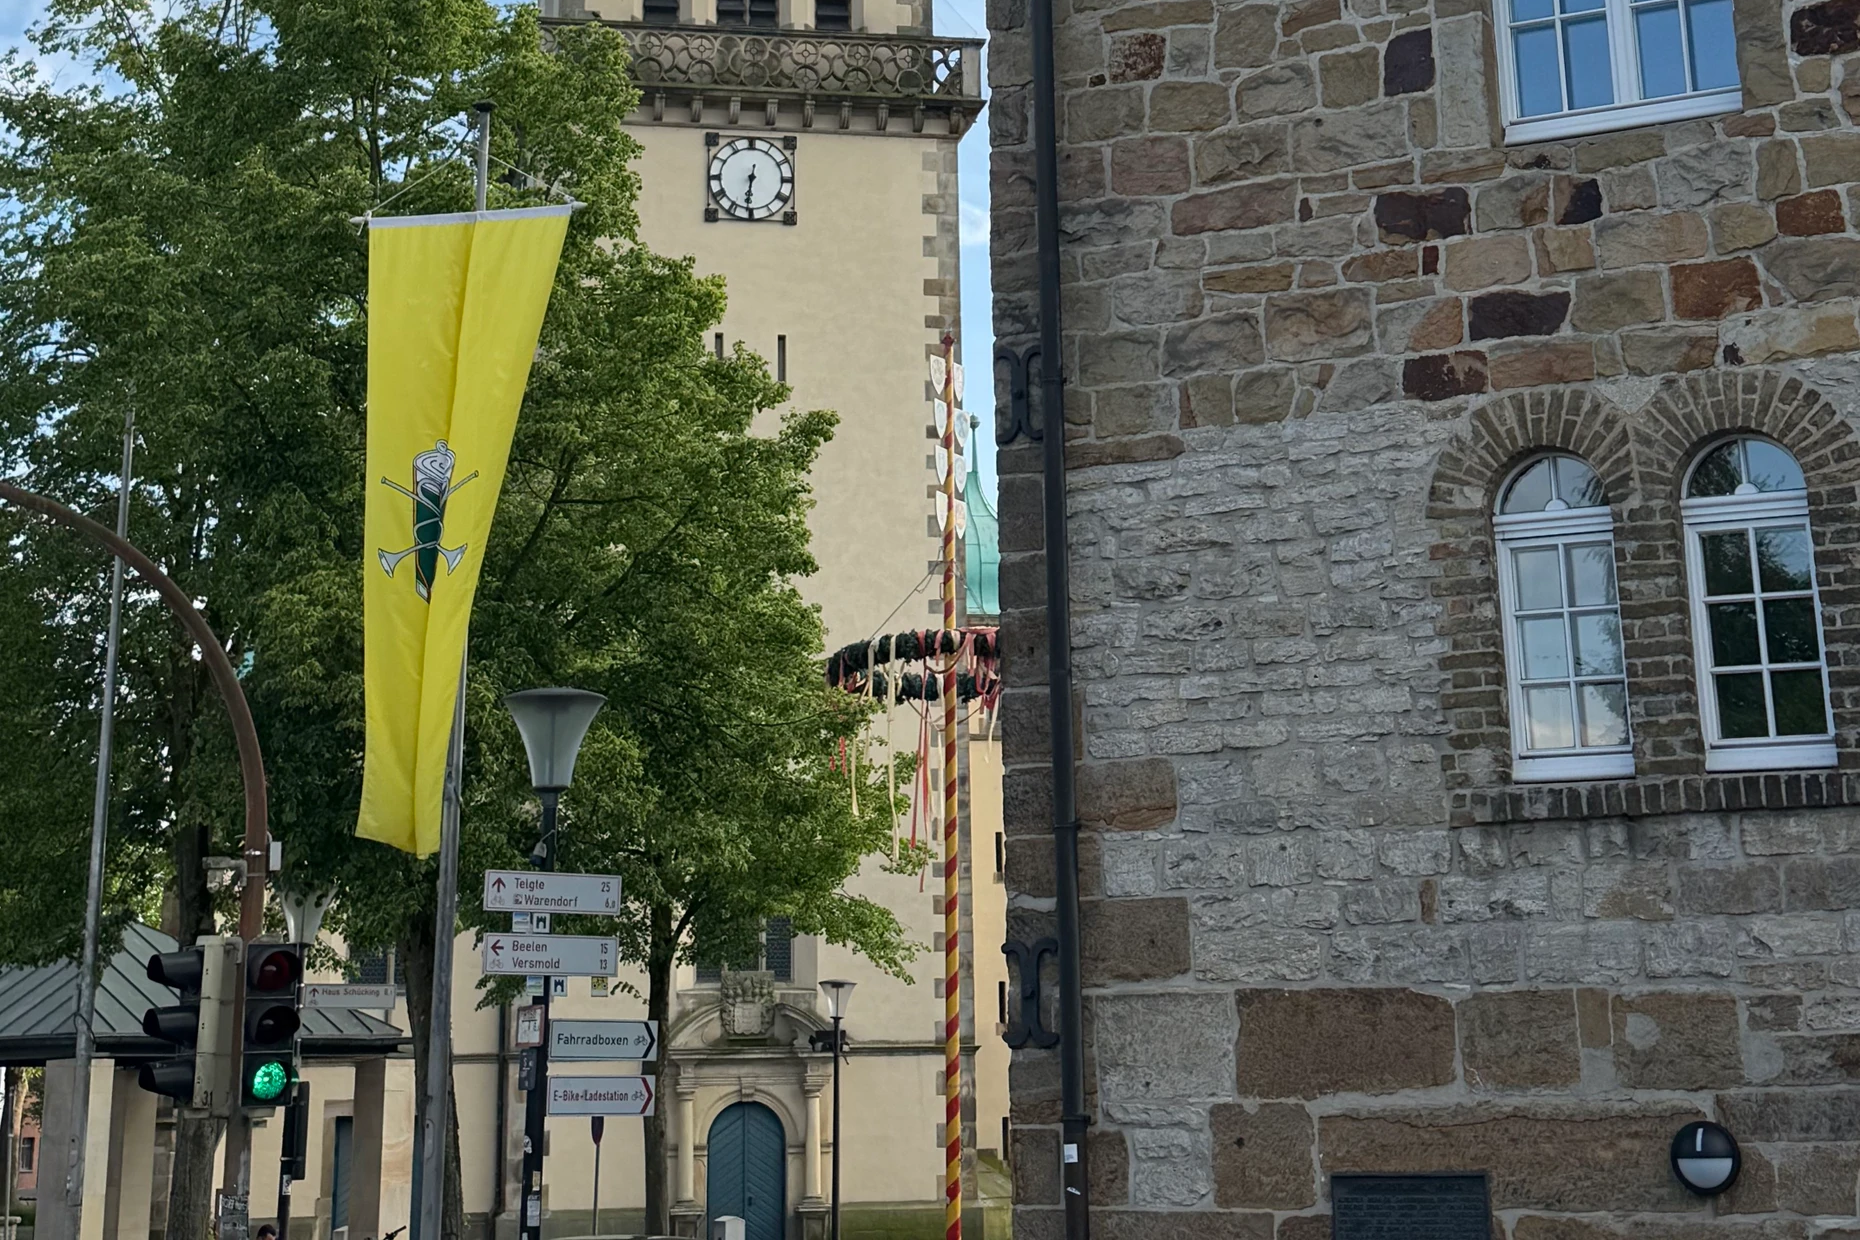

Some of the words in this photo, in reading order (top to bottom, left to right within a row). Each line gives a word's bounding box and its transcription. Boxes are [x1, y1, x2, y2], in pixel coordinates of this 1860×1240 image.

[514, 877, 545, 891] Telgte
[601, 881, 611, 893] 25
[524, 894, 578, 908] Warendorf
[512, 940, 547, 953] Beelen
[600, 943, 608, 954] 15
[512, 957, 561, 969] Versmold
[599, 959, 608, 970] 13
[321, 988, 340, 996] Haus
[343, 988, 380, 998] Schücking
[557, 1033, 629, 1046] Fahrradboxen
[553, 1089, 629, 1102] E-Bike-Ladestation
